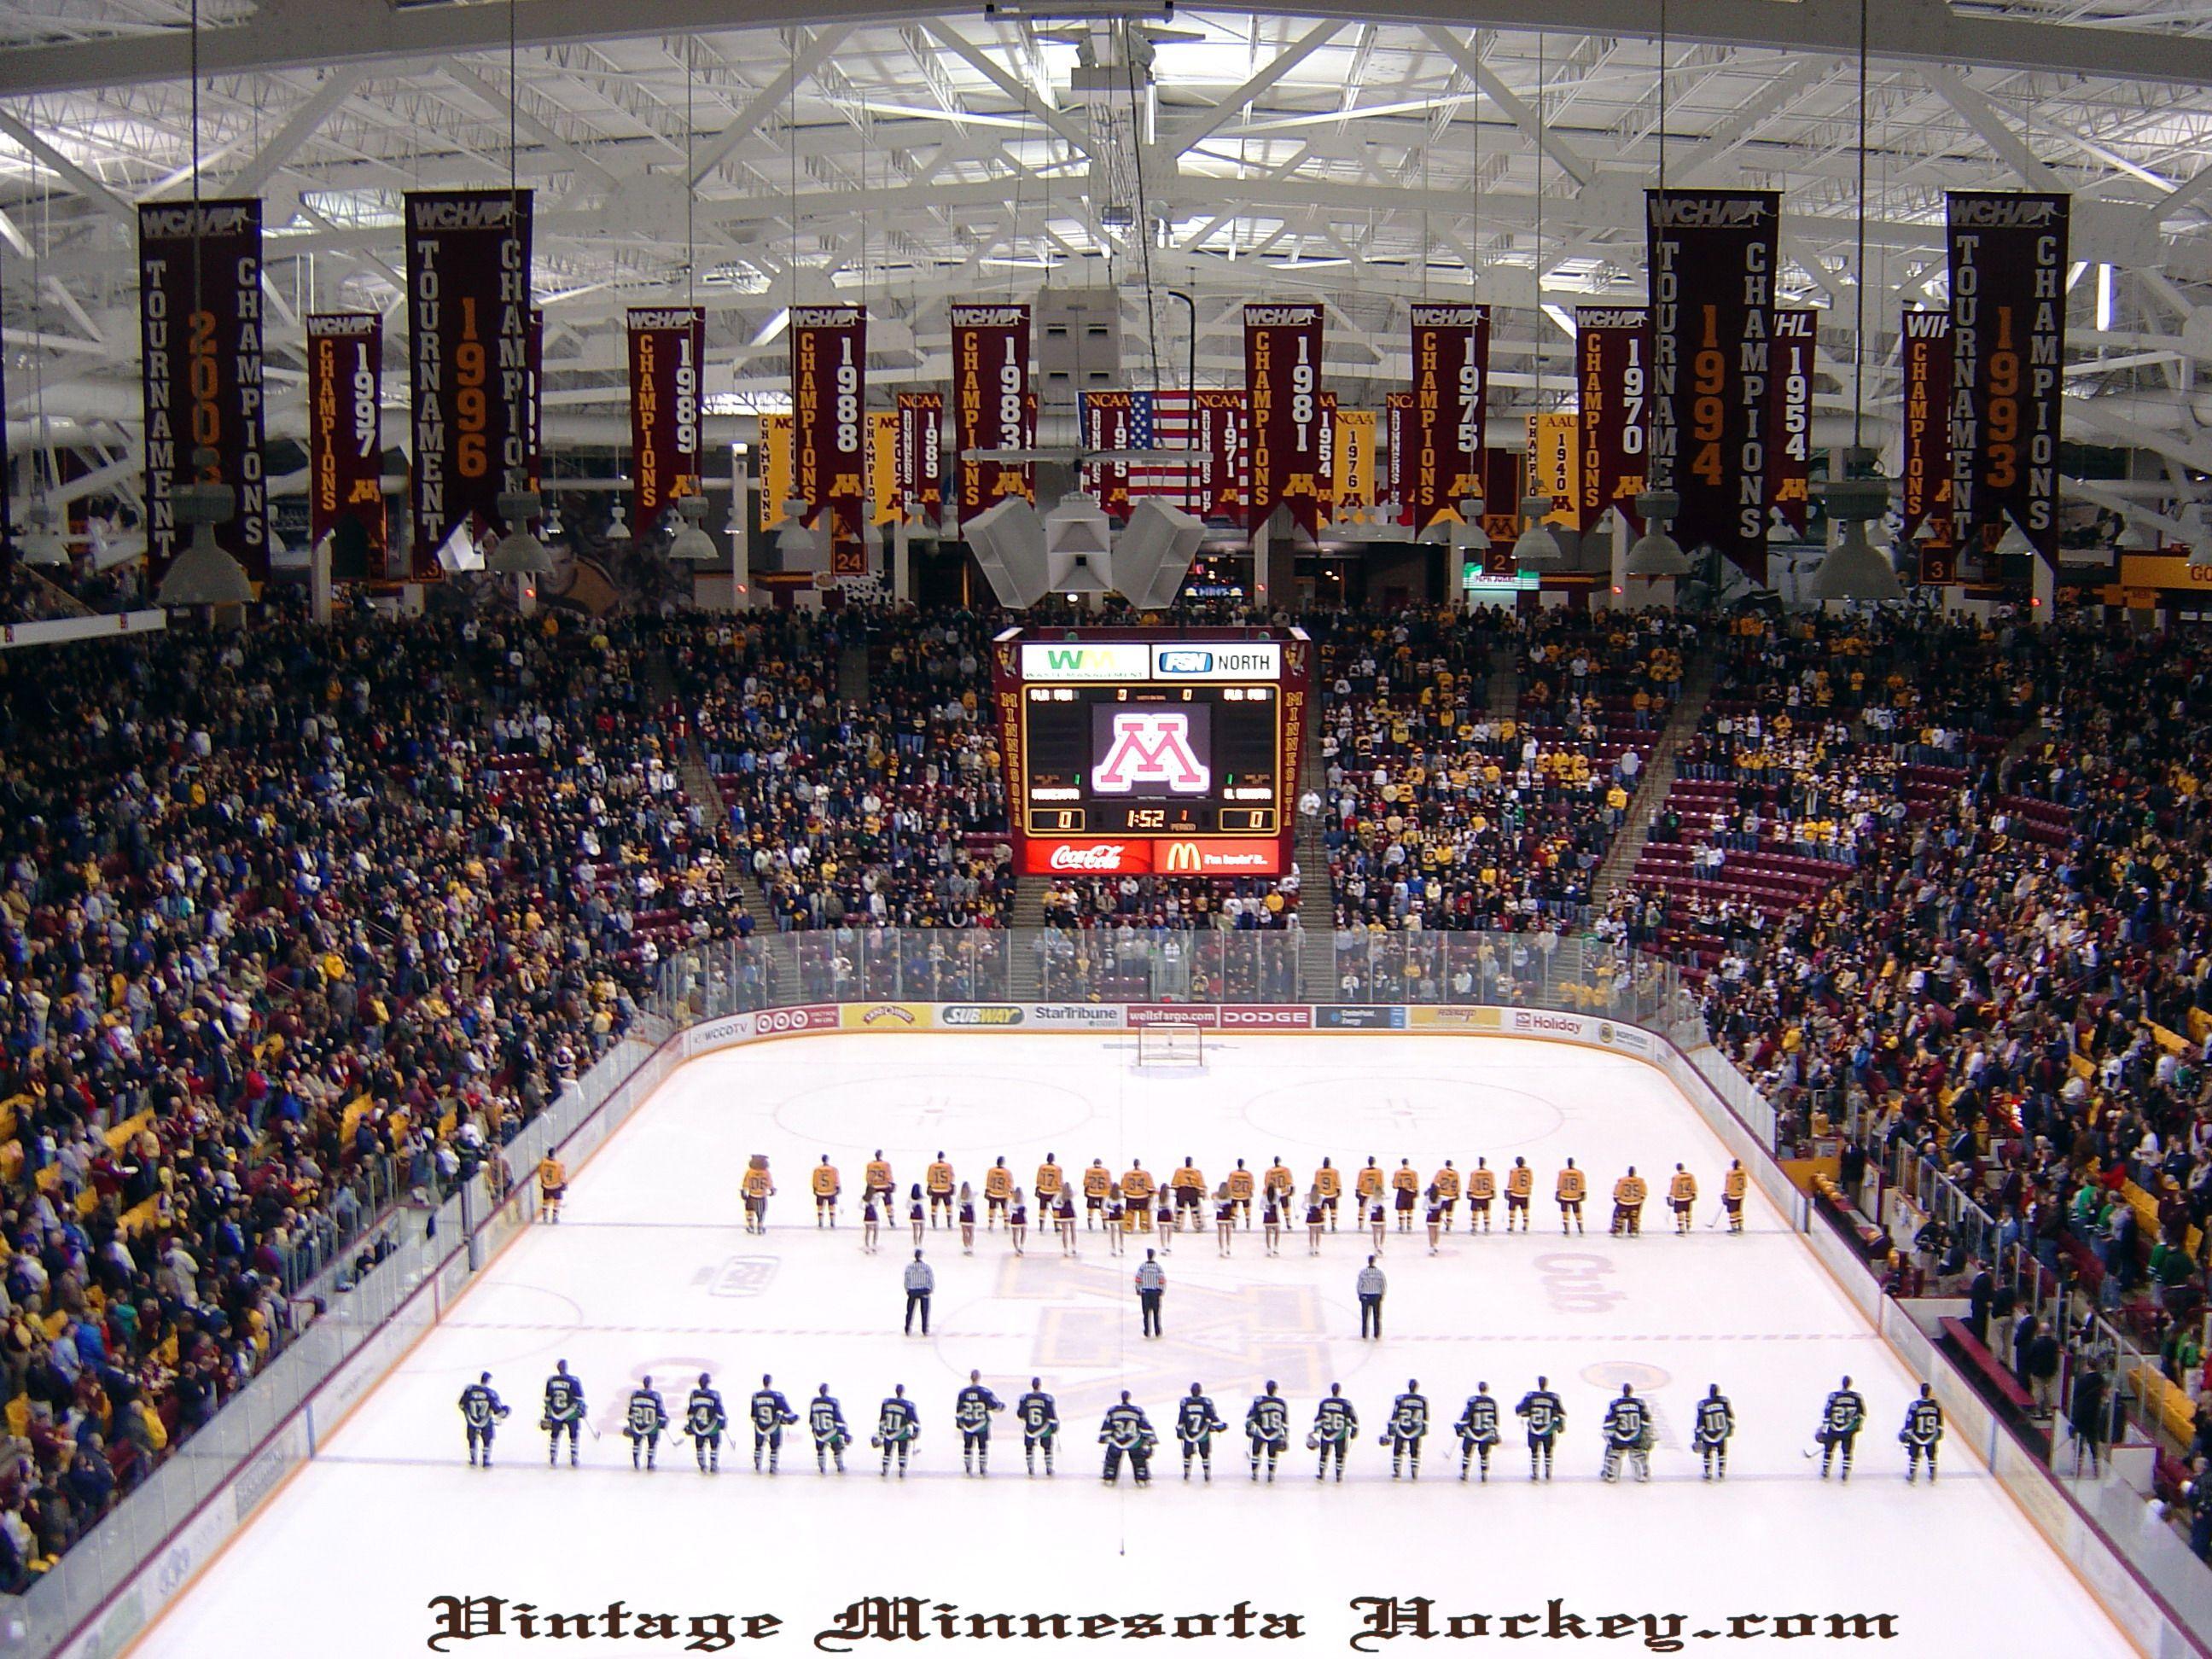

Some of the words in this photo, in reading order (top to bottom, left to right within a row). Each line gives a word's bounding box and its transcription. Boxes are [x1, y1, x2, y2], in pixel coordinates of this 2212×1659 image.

[417, 240, 445, 541] TOURNAMENT
[457, 297, 487, 478] 1996
[1740, 242, 1768, 538] CHAMPIONS
[1952, 236, 1979, 540] TOURNAMENT
[2029, 236, 2058, 529] CHAMPIONS
[237, 258, 264, 544] CHAMPIONS
[354, 343, 375, 457] 1997
[676, 339, 696, 453] 1989
[836, 337, 858, 452] 1988
[899, 395, 943, 408] NCAA
[1000, 337, 1021, 451] 1983
[1088, 395, 1131, 407] NCAA
[1196, 395, 1241, 407] NCAA
[1292, 336, 1313, 452] 1981
[1458, 337, 1479, 452] 1975
[1623, 339, 1644, 454] 1970
[1692, 305, 1725, 485] 1994
[1987, 306, 2018, 487] 1993
[146, 259, 176, 557] TOURNAMENT
[1785, 347, 1806, 461] 1954
[319, 340, 336, 510] CHAMPIONS
[638, 335, 656, 507] CHAMPIONS
[800, 332, 818, 505] CHAMPIONS
[1254, 331, 1272, 506] CHAMPIONS
[1336, 413, 1375, 425] NCAA
[1420, 332, 1438, 505] CHAMPIONS
[1545, 416, 1578, 427] AAU
[1585, 333, 1603, 506] CHAMPIONS
[1909, 343, 1928, 515] CHAMPIONS
[903, 410, 912, 485] RUNNERS
[925, 411, 938, 479] 1989
[1115, 411, 1127, 478] 195
[1224, 411, 1237, 478] 1971
[1318, 410, 1332, 478] 1954
[1348, 429, 1359, 489] 1976
[1556, 434, 1567, 491] 1940
[760, 419, 771, 521] CHAMPIONS
[1202, 491, 1212, 512] UP
[837, 555, 861, 569] 24
[1494, 555, 1505, 570] 2
[1931, 562, 1943, 578] 3
[1219, 655, 1270, 670] NORTH
[1000, 692, 1022, 827] MINNESOTA
[1096, 718, 1206, 788] M
[1284, 691, 1303, 826] MINNESOTA
[1058, 811, 1072, 828] 0
[1127, 810, 1164, 828] 1:52
[1249, 811, 1263, 828] 0
[946, 1008, 1020, 1023] SUBWAY
[1035, 1006, 1117, 1019] StarTribune
[1129, 1010, 1214, 1022] wellsfargo.com
[1223, 1012, 1308, 1022] DODGE
[1534, 1016, 1582, 1034] Holiday
[934, 1170, 949, 1185] 15
[1041, 1173, 1056, 1187] 17
[1128, 1178, 1145, 1190] 34
[1624, 1184, 1639, 1196] 35
[555, 1390, 568, 1408] 2
[470, 1400, 489, 1418] 17
[632, 1408, 656, 1424] 20
[696, 1407, 709, 1424] 4
[760, 1407, 771, 1422] 9
[963, 1402, 986, 1420] 22
[1029, 1408, 1042, 1426] 6
[1399, 1409, 1423, 1427] 24
[1529, 1407, 1552, 1425] 21
[1831, 1406, 1858, 1424] 27
[812, 1412, 834, 1430] 16
[885, 1412, 901, 1429] 11
[1112, 1420, 1138, 1438] 34
[1189, 1414, 1202, 1432] 7
[1323, 1412, 1344, 1430] 26
[1473, 1412, 1494, 1429] 15
[1616, 1413, 1640, 1431] 30
[1705, 1412, 1726, 1431] 10
[1917, 1416, 1938, 1434] 19
